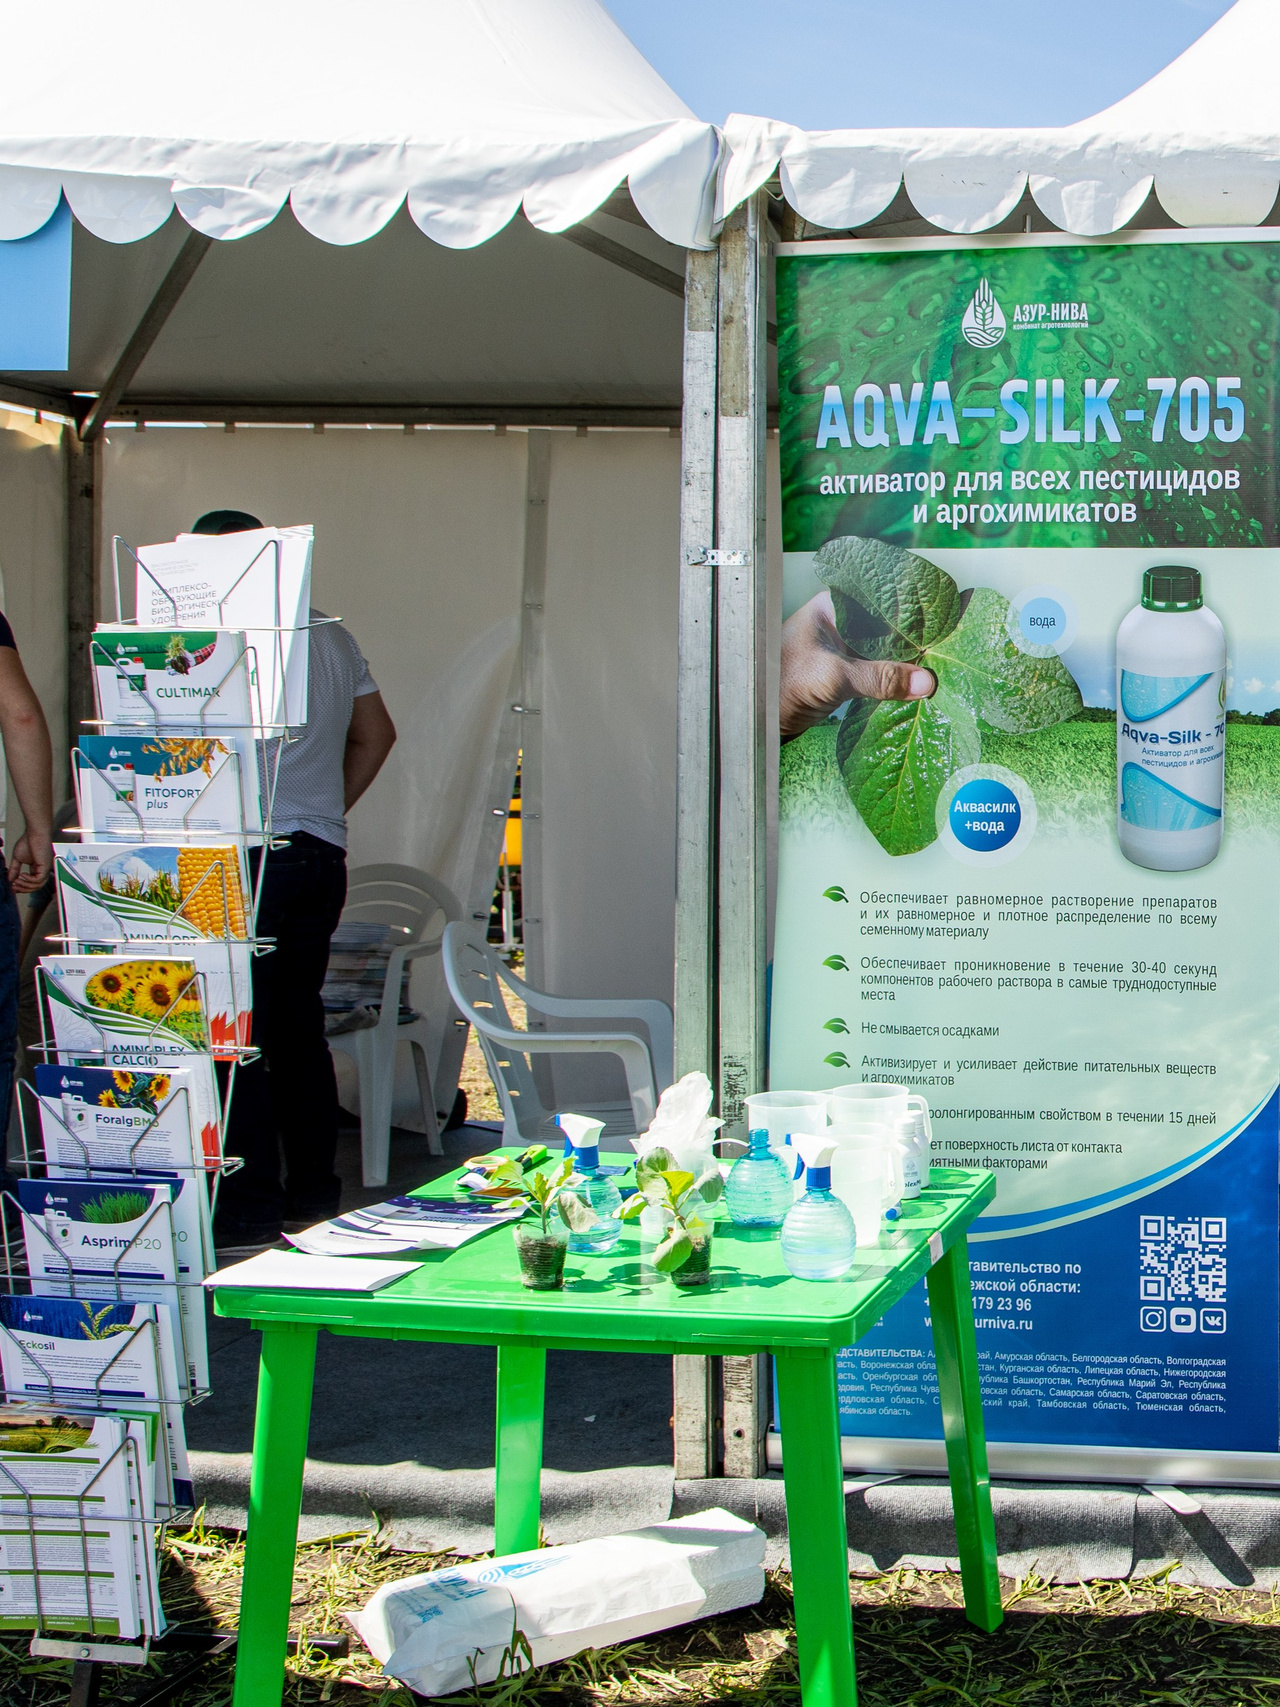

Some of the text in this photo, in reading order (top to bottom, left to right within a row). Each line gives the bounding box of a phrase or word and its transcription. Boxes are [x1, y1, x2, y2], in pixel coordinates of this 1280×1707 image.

[1013, 303, 1088, 322] АЗУР-НИВА
[1041, 321, 1089, 330] агротехнологий
[820, 464, 1240, 497] активатор для всех пестицидов
[913, 503, 1136, 530] и аргохимикатов
[1030, 617, 1056, 629] вода
[156, 686, 220, 697] CULTIMAR
[1122, 722, 1201, 743] Aqva-Silk
[1141, 745, 1214, 758] Активатор всех
[1141, 758, 1187, 768] пестицидов
[145, 787, 202, 797] FITOFORT
[146, 798, 168, 809] plus
[954, 800, 1016, 813] Аквасилк
[965, 820, 1005, 834] +вода
[860, 891, 1043, 908] Обеспечивает равномерное
[1180, 915, 1217, 928] всему
[926, 927, 989, 940] материалу
[954, 961, 1217, 978] проникновение течение 30-40 секунд
[939, 974, 1217, 994] рабочего раствора труднодоступные
[861, 991, 896, 1001] места
[862, 1022, 999, 1039] Не смывается осадками
[861, 1055, 937, 1072] Активизирует
[1039, 1108, 1216, 1127] свойством течении дней
[945, 1141, 1123, 1153] поверхность контакта
[982, 1155, 1047, 1172] факторами
[1065, 1264, 1081, 1274] по
[1020, 1279, 1080, 1293] области:
[972, 1296, 1031, 1311] 179 23 96
[860, 1360, 914, 1370] Воронежская
[994, 1351, 1226, 1367] Амурская Белгородская Волгоградская
[1164, 1368, 1226, 1379] Нижегородская
[1135, 1402, 1183, 1411] Тюменская
